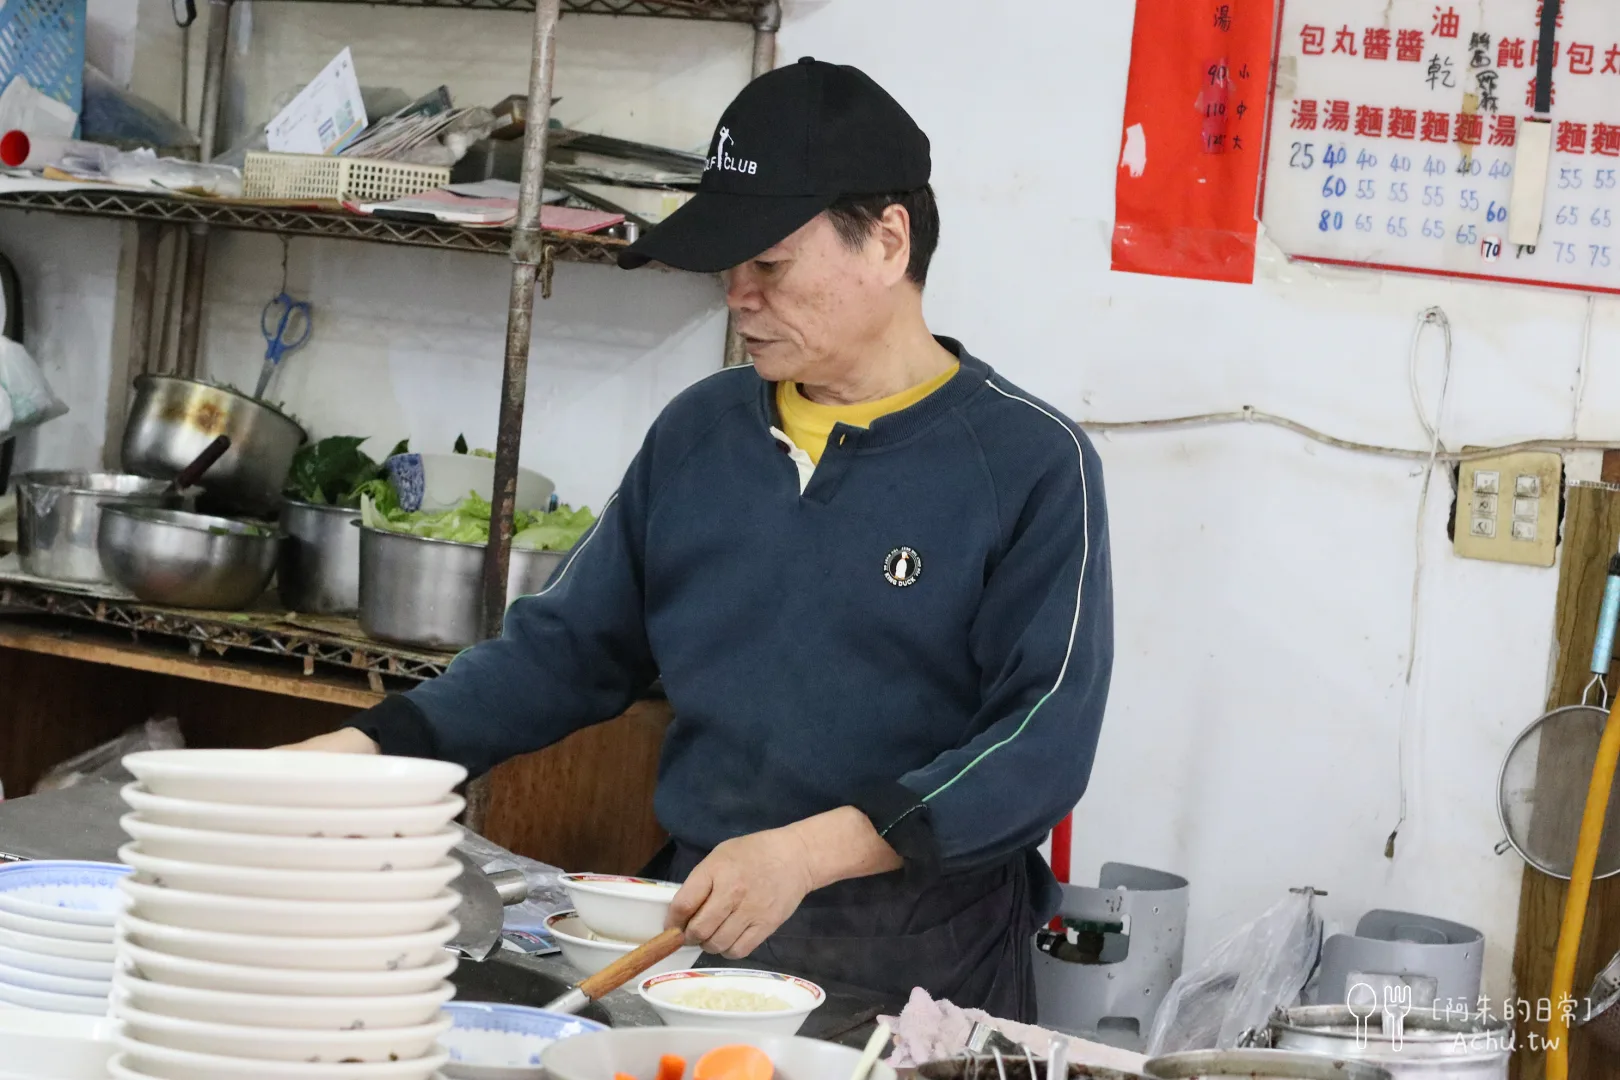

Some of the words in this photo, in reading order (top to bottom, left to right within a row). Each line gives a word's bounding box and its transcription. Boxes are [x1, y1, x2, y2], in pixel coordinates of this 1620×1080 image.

[1214, 5, 1231, 32] 湯
[1208, 65, 1227, 85] 90
[1425, 54, 1455, 90] 乾
[1207, 103, 1225, 117] 110
[1233, 135, 1243, 150] 大
[724, 156, 758, 175] CLUB
[1289, 142, 1314, 170] 25
[1322, 144, 1346, 168] 40
[1356, 148, 1377, 170] 40
[1390, 153, 1411, 172] 40
[1423, 155, 1446, 177] 40
[1456, 154, 1481, 176] 40
[1488, 158, 1512, 180] 40
[1558, 168, 1583, 189] 55
[1594, 169, 1616, 189] 55
[1322, 175, 1346, 198] 60
[1356, 179, 1375, 200] 55
[1388, 182, 1408, 203] 55
[1422, 185, 1445, 207] 55
[1459, 189, 1479, 212] 55
[1486, 200, 1507, 222] 60
[1556, 205, 1580, 226] 65
[1590, 207, 1612, 228] 65
[1318, 209, 1343, 232] 80
[1355, 213, 1373, 232] 65
[1387, 216, 1408, 238] 65
[1421, 218, 1445, 239] 65
[1456, 224, 1477, 245] 65
[1483, 240, 1501, 258] 70
[1553, 241, 1576, 264] 75
[1589, 244, 1611, 268] 75
[898, 576, 917, 587] DUCK
